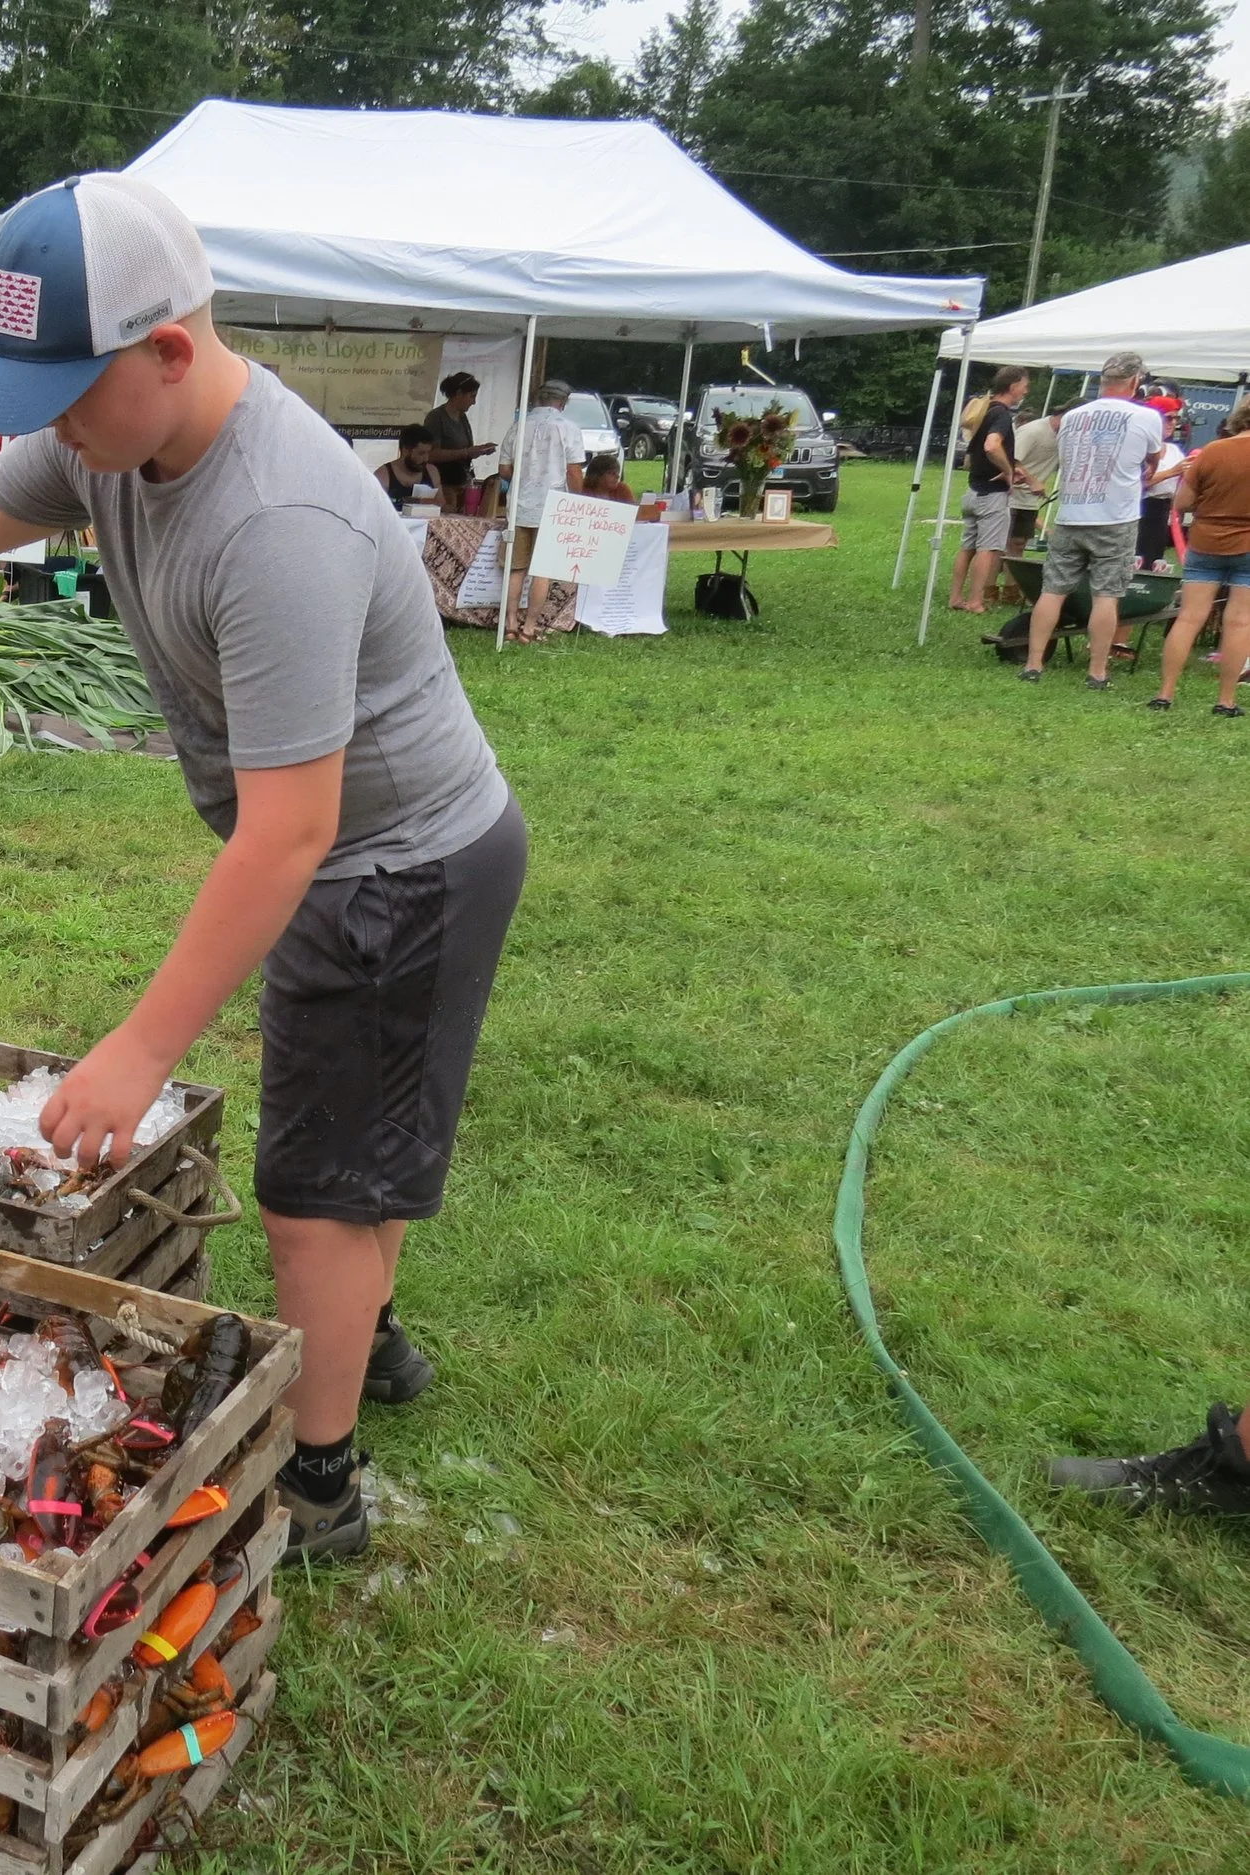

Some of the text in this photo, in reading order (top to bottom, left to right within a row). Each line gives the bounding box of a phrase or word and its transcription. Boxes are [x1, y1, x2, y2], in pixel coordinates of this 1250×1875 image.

[135, 306, 169, 326] Columbia
[271, 337, 317, 358] Jane
[325, 339, 376, 362] Lloyd
[298, 366, 325, 375] Helping
[326, 366, 351, 375] Cancer
[380, 367, 393, 376] Day
[1090, 410, 1133, 432] ROCK
[556, 498, 610, 518] CLAMBAKE
[550, 513, 627, 536] TICKET HOLDERS
[556, 532, 600, 546] CHECK IN
[566, 546, 598, 559] HERE
